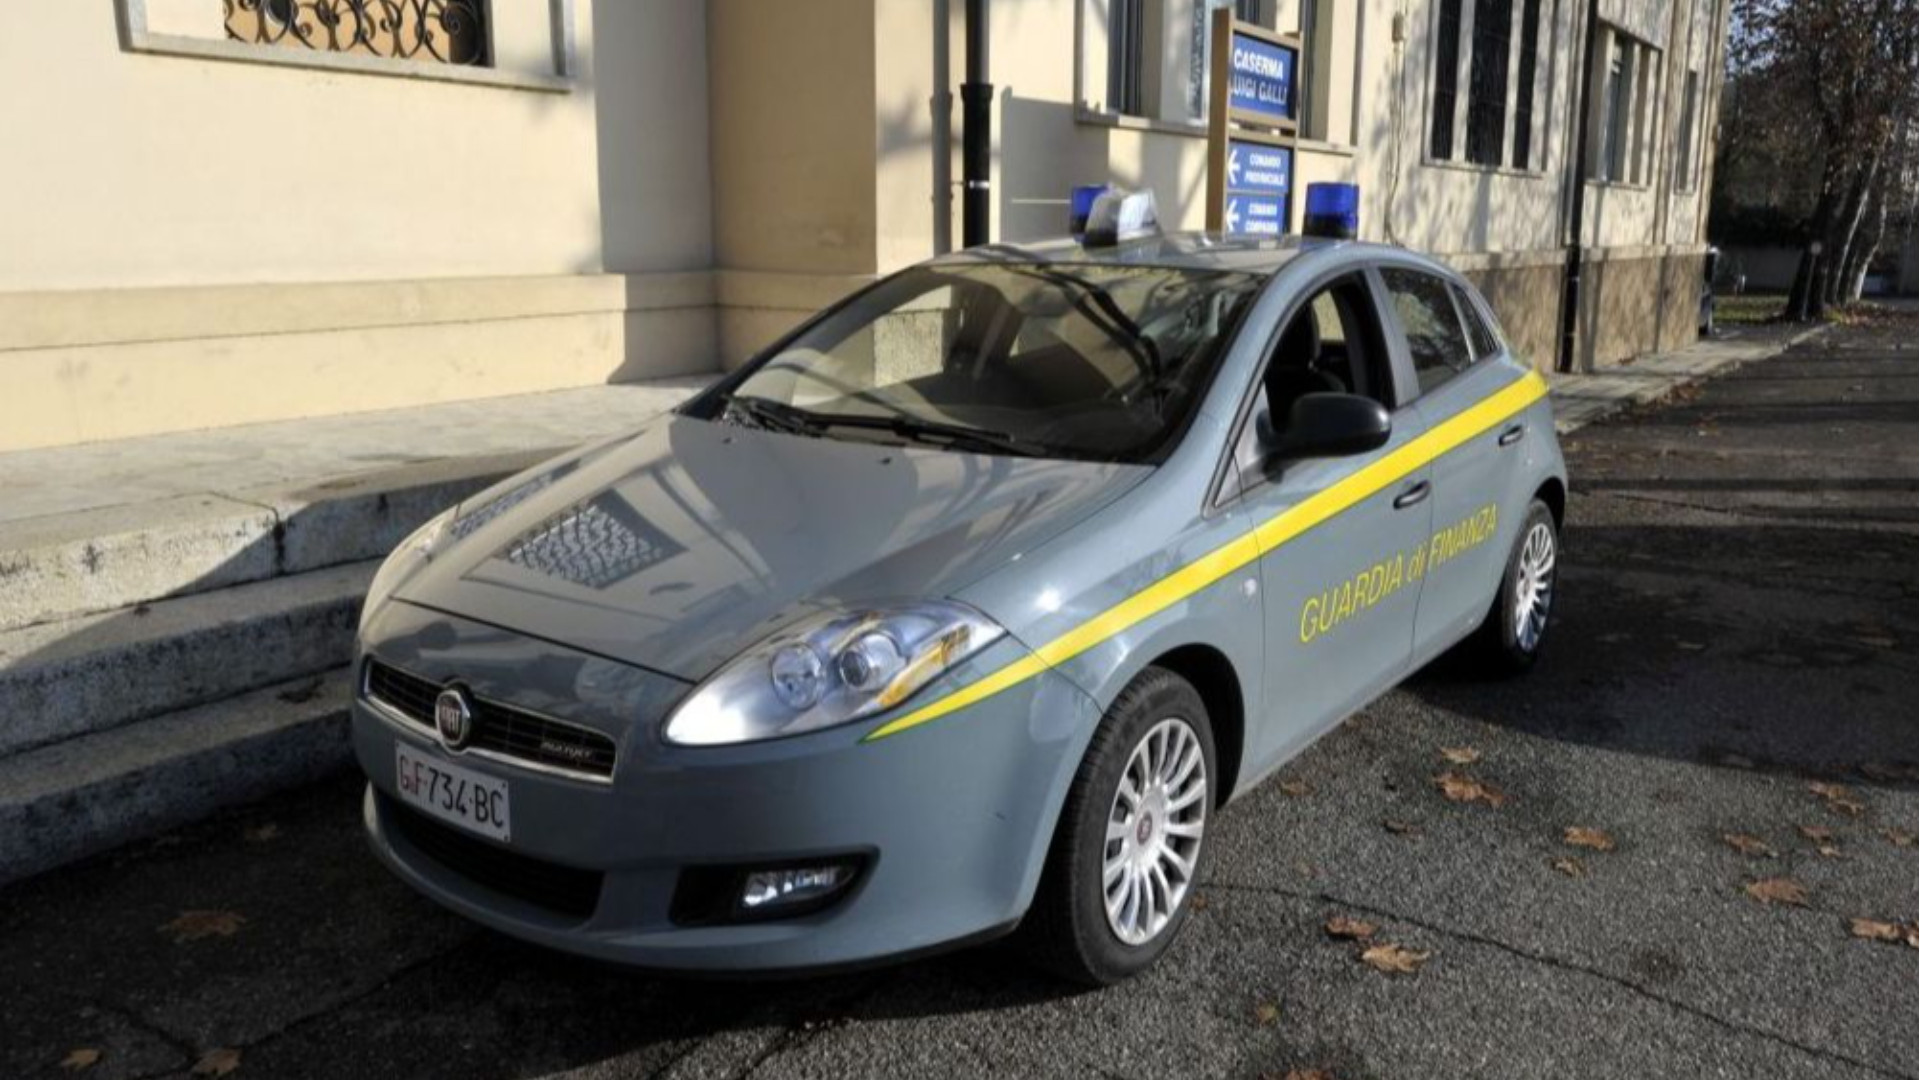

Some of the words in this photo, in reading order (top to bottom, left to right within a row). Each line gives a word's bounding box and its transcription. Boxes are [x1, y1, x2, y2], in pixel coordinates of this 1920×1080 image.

[1234, 48, 1284, 80] CASERMA
[1259, 81, 1287, 106] GALLI
[1301, 553, 1403, 642] GUARDIA
[1407, 541, 1427, 583] di
[1428, 503, 1496, 572] FINANZA
